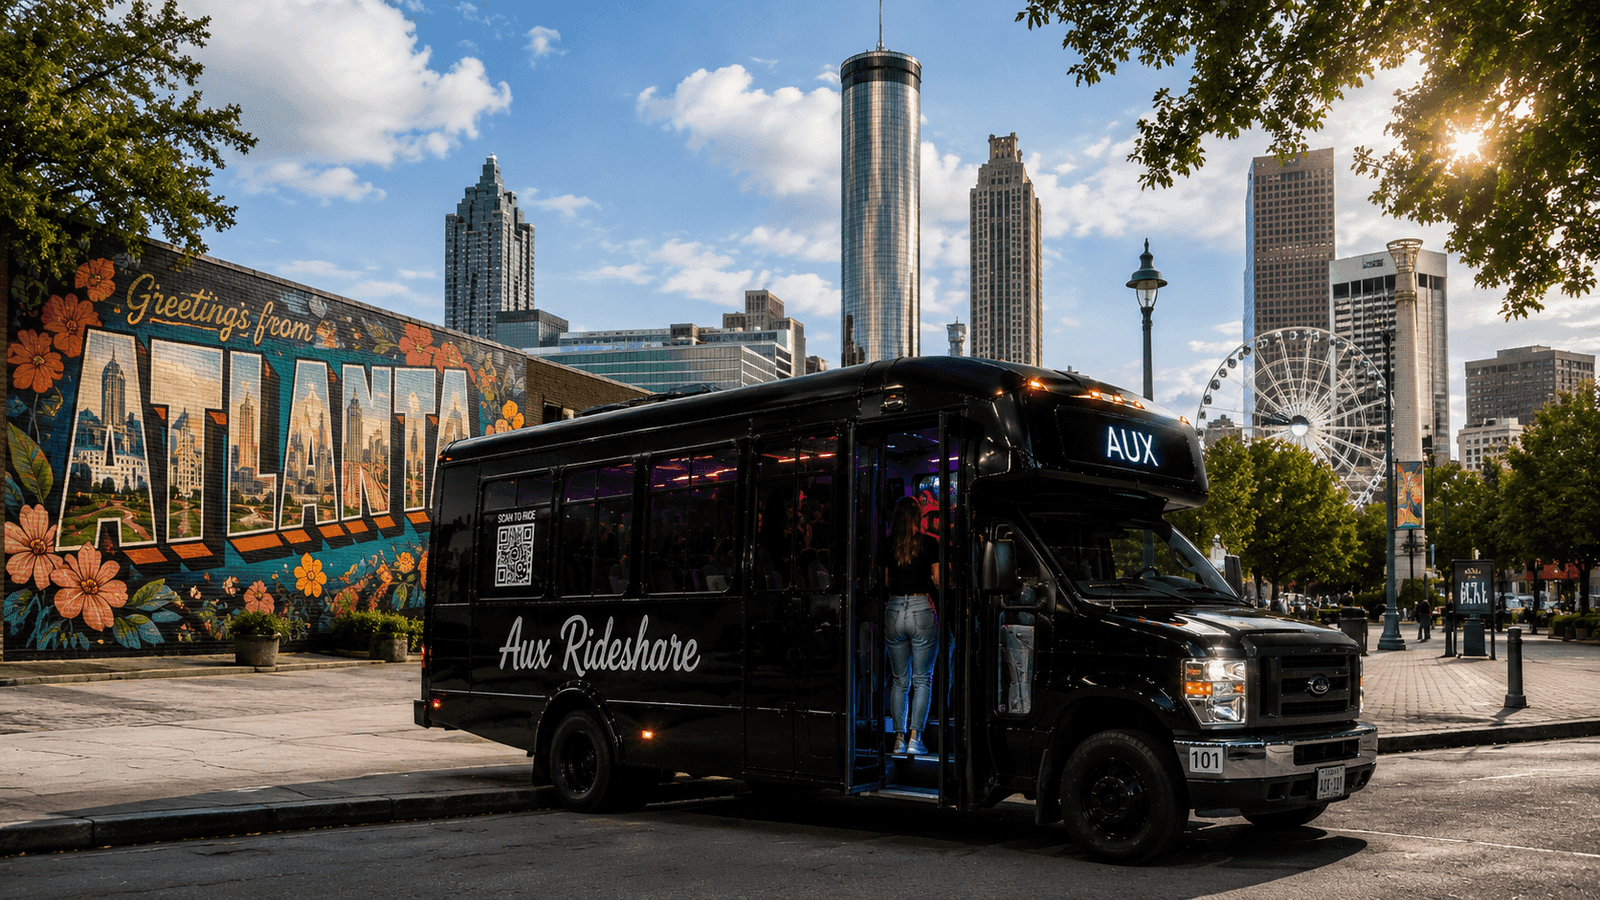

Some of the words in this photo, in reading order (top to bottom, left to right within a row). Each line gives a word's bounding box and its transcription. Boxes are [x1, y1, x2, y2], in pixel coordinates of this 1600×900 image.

[254, 301, 313, 347] from
[1107, 426, 1159, 467] AUX
[499, 615, 552, 671] Aux
[560, 614, 701, 677] Rideshare
[1191, 750, 1219, 769] 101
